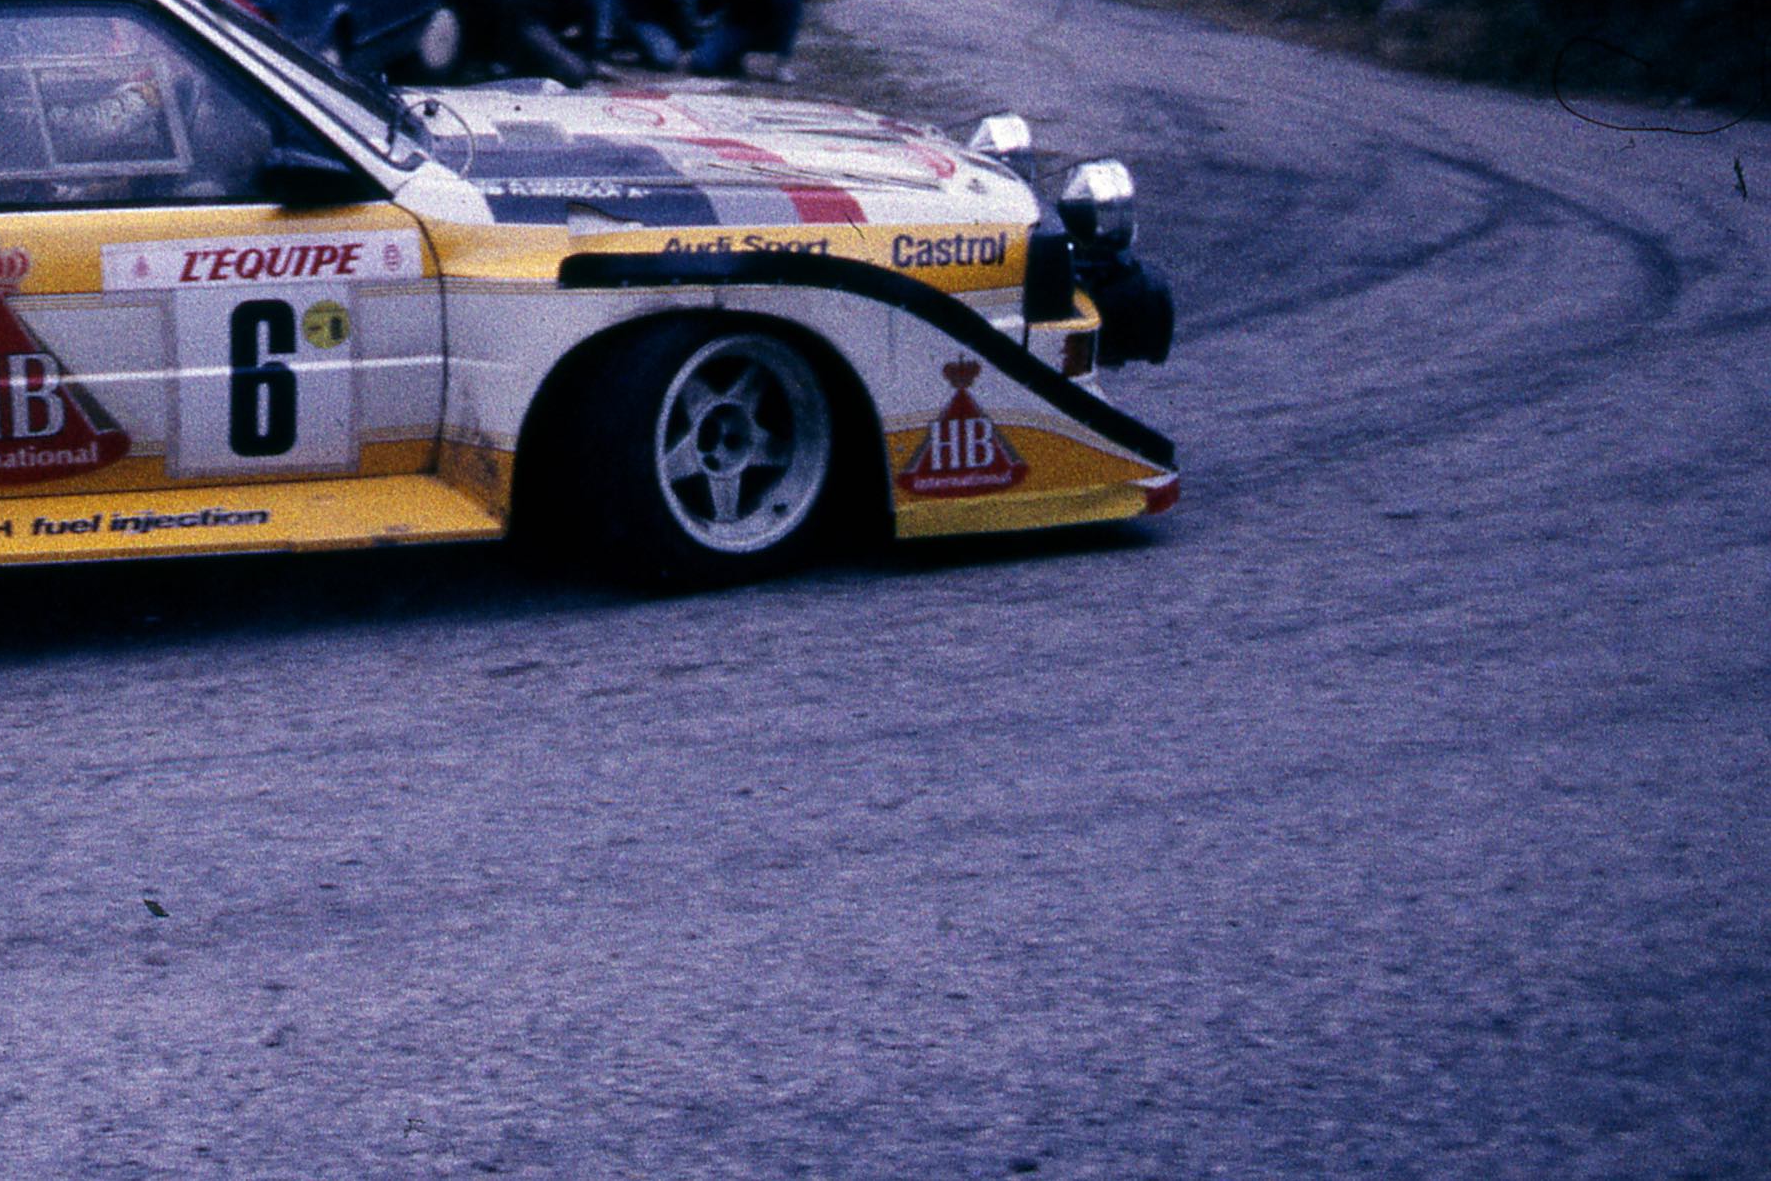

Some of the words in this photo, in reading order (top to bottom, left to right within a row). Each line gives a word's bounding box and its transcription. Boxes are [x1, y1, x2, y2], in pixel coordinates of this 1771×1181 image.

[180, 243, 363, 282] L'EQUIPE
[892, 232, 1008, 268] Castrol
[230, 299, 297, 457] 6
[930, 417, 996, 469] HB
[32, 514, 102, 536] fuel
[110, 507, 270, 534] injection
